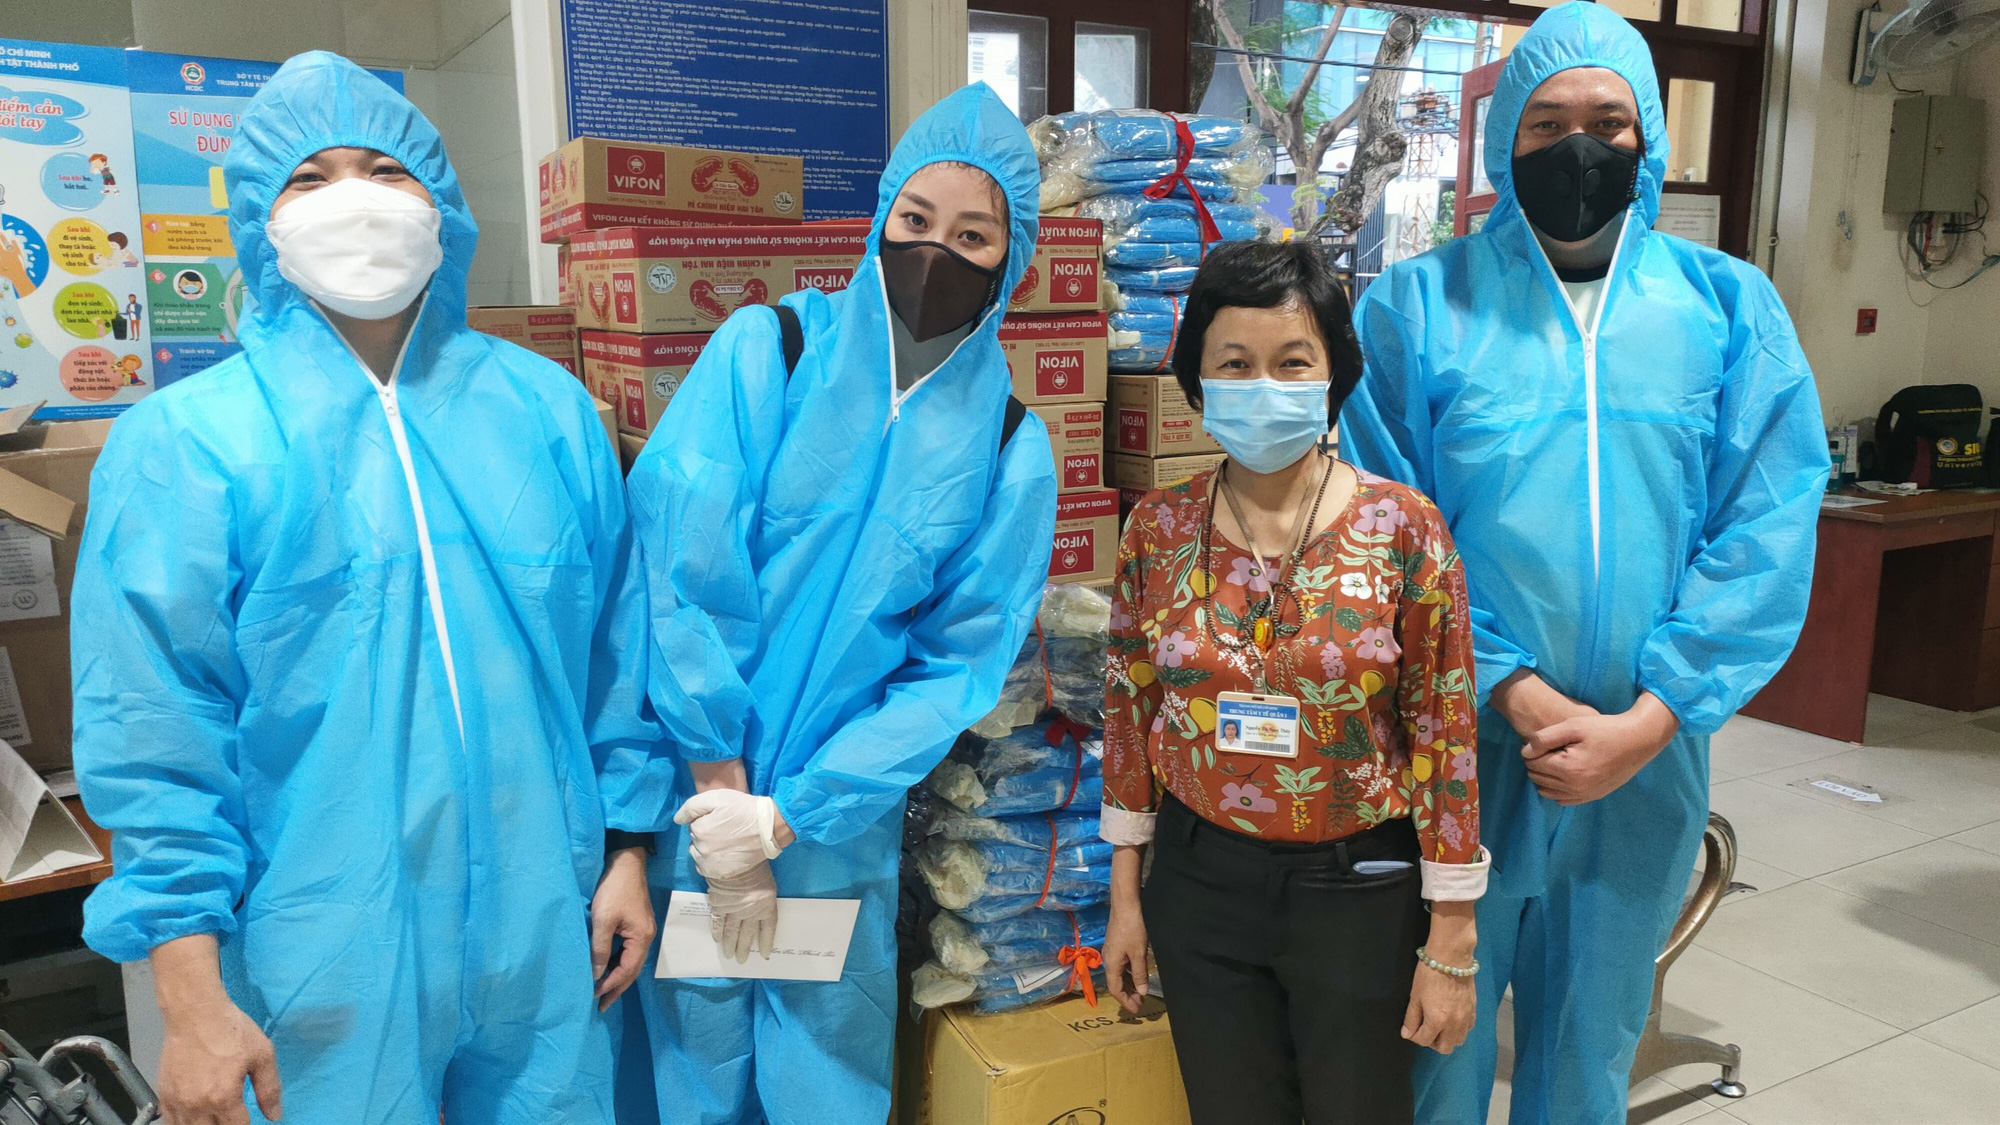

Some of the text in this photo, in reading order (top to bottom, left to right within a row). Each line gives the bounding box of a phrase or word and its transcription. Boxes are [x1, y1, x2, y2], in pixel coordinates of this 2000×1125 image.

[25, 50, 51, 58] MINH
[24, 60, 58, 70] THÀNH
[58, 62, 80, 71] PHỐ
[34, 98, 62, 115] cần
[20, 116, 44, 130] tay
[168, 106, 232, 130] SỬ DỤNG
[196, 130, 231, 153] ĐÚN
[614, 174, 660, 190] VIFON
[592, 214, 617, 222] VIFON
[638, 214, 652, 226] KẾT
[654, 217, 679, 227] KHÔNG
[1039, 227, 1100, 242] VIFON XUẤT
[648, 235, 866, 249] FON CAM KẾT KHÔNG SỬ DỤNG PHẨM MÀU TỔNG HỢP
[736, 260, 760, 268] CHÍNH
[1054, 263, 1093, 276] VIFON
[614, 279, 633, 292] VIFON
[800, 274, 848, 288] VIFON
[1001, 322, 1015, 330] DỤN
[1016, 322, 1026, 332] SỬ
[1028, 322, 1052, 330] KHÔNG
[1052, 322, 1065, 331] KẾT
[654, 344, 698, 356] TỔNG HỢP
[1040, 356, 1079, 368] VIFON
[626, 384, 642, 400] VIFON
[1122, 415, 1145, 427] VIFON
[1066, 458, 1096, 468] VIFON
[1062, 503, 1075, 512] KẾT
[1052, 535, 1090, 550] VIFON
[1067, 1016, 1114, 1033] KCS
